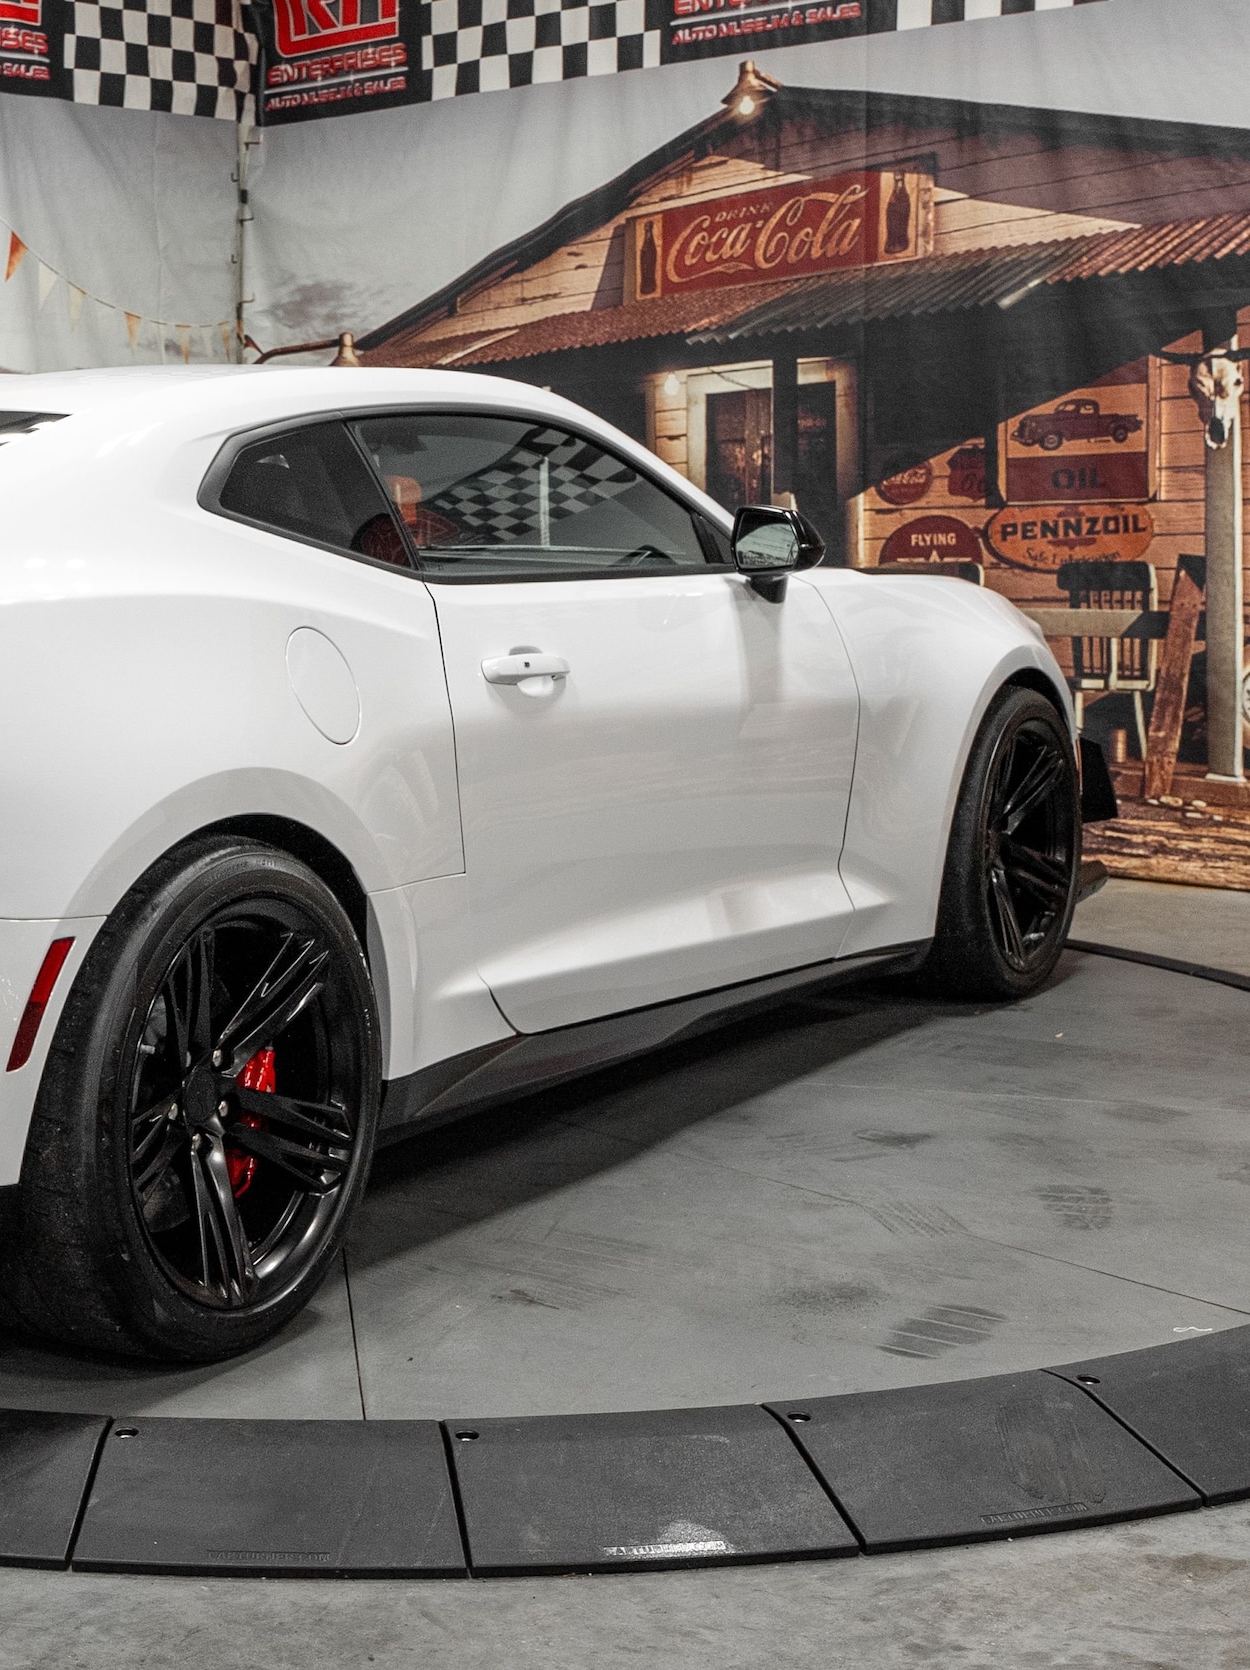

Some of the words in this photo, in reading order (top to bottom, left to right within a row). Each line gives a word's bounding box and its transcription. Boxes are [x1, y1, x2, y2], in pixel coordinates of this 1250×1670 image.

[671, 25, 717, 45] AUTO
[718, 15, 790, 38] MUSEUM
[791, 11, 803, 26] &
[805, 2, 861, 24] SALES
[3, 63, 50, 80] SALES
[267, 42, 408, 85] ENTERPRISES
[265, 94, 300, 111] AUTO
[364, 76, 407, 95] SALES
[715, 200, 772, 223] DRINK
[666, 184, 870, 283] Coca-Cola
[1052, 467, 1105, 489] OIL
[911, 533, 957, 546] FLYING
[1001, 514, 1148, 542] PENNZOIL
